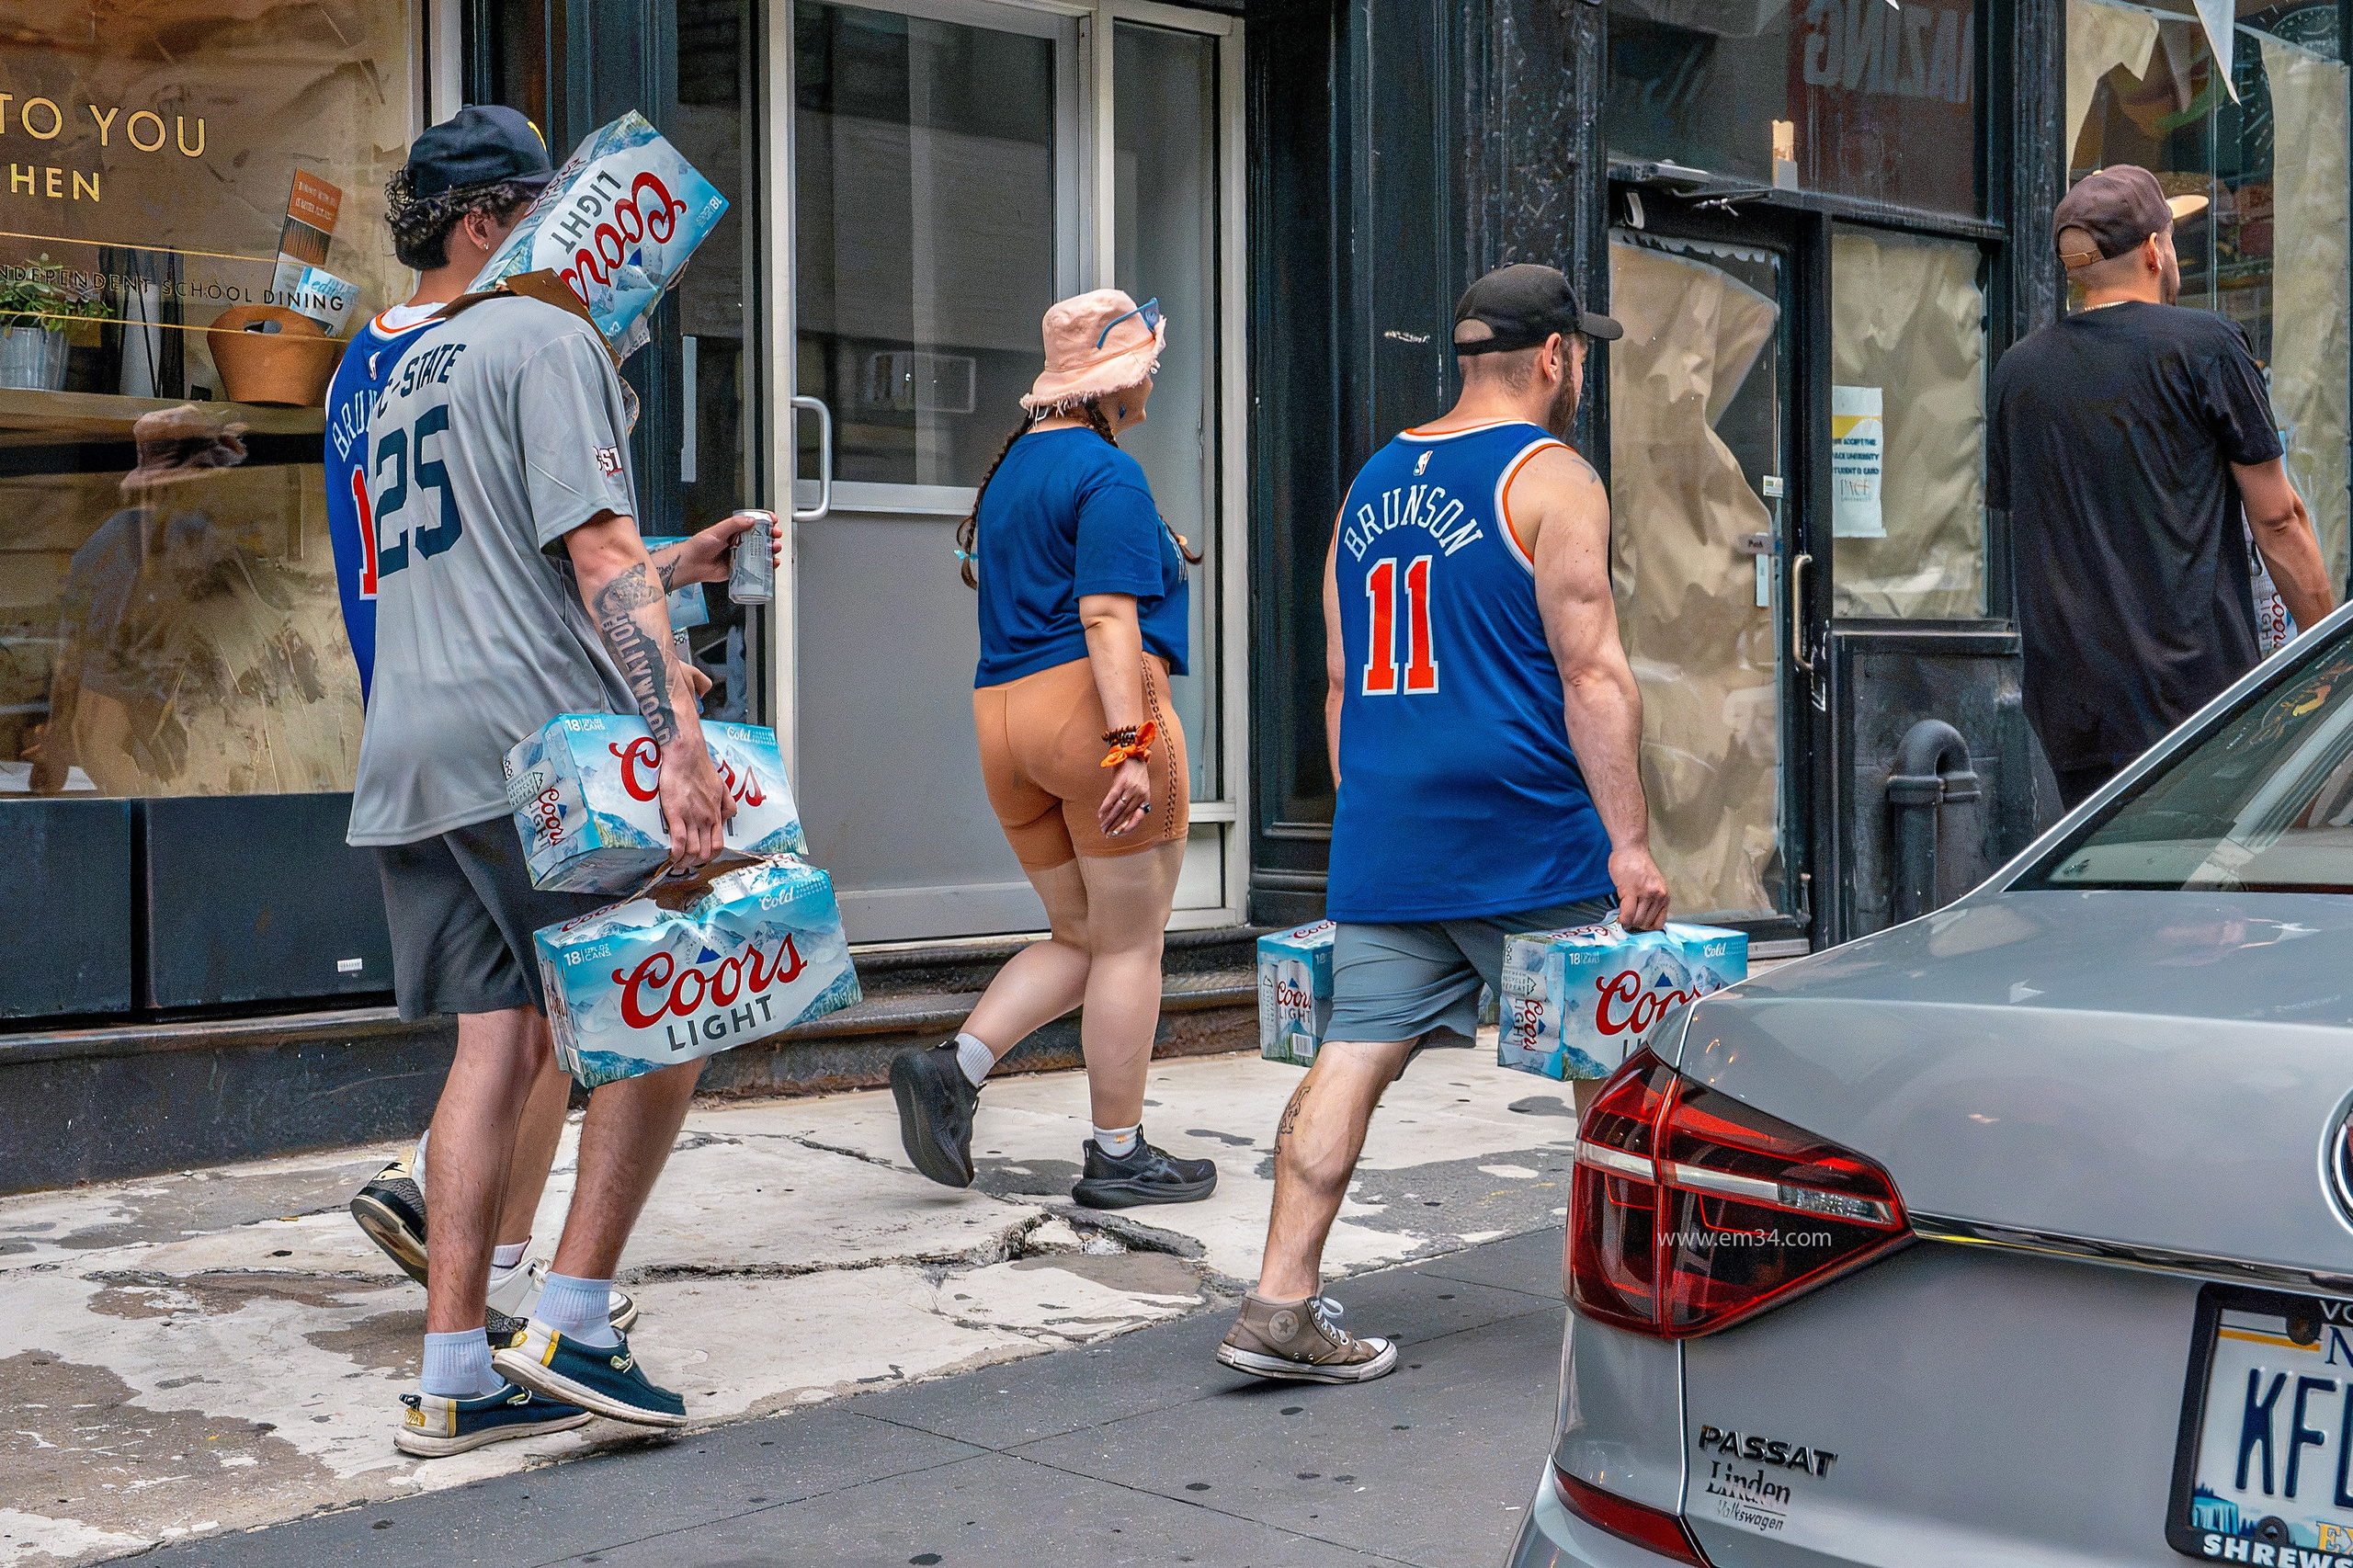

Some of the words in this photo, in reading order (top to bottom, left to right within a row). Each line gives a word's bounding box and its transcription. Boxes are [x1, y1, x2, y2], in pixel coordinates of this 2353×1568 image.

[0, 93, 63, 140] TO
[89, 104, 205, 157] YOU
[10, 163, 100, 202] HEN
[709, 195, 722, 210] 18
[551, 170, 622, 255] LIGHT
[560, 171, 688, 309] Coors
[162, 279, 252, 304] SCHOOL
[263, 290, 344, 312] DINING
[378, 404, 462, 579] 25
[1344, 483, 1484, 562] BRUNSON
[1361, 554, 1439, 696] 11
[563, 719, 581, 732] 18
[726, 726, 752, 743] Cold
[608, 736, 767, 808] Crs
[529, 799, 551, 849] LIGHT
[538, 787, 567, 846] Coors
[759, 886, 795, 911] Cold
[563, 951, 582, 966] 18
[585, 949, 611, 962] CANS
[1314, 953, 1326, 966] 18
[1569, 952, 1581, 965] 18
[1703, 941, 1727, 959] Cold
[611, 933, 808, 1028] Coors
[1277, 981, 1313, 1010] Coors
[666, 994, 773, 1051] LIGHT
[1279, 1007, 1312, 1024] LIGHT
[1514, 998, 1525, 1046] LIGHT
[1524, 998, 1544, 1052] Coors
[1699, 1424, 1838, 1479] PASSAT
[1706, 1459, 1790, 1506] Linden
[1716, 1499, 1784, 1532] Volkswagen
